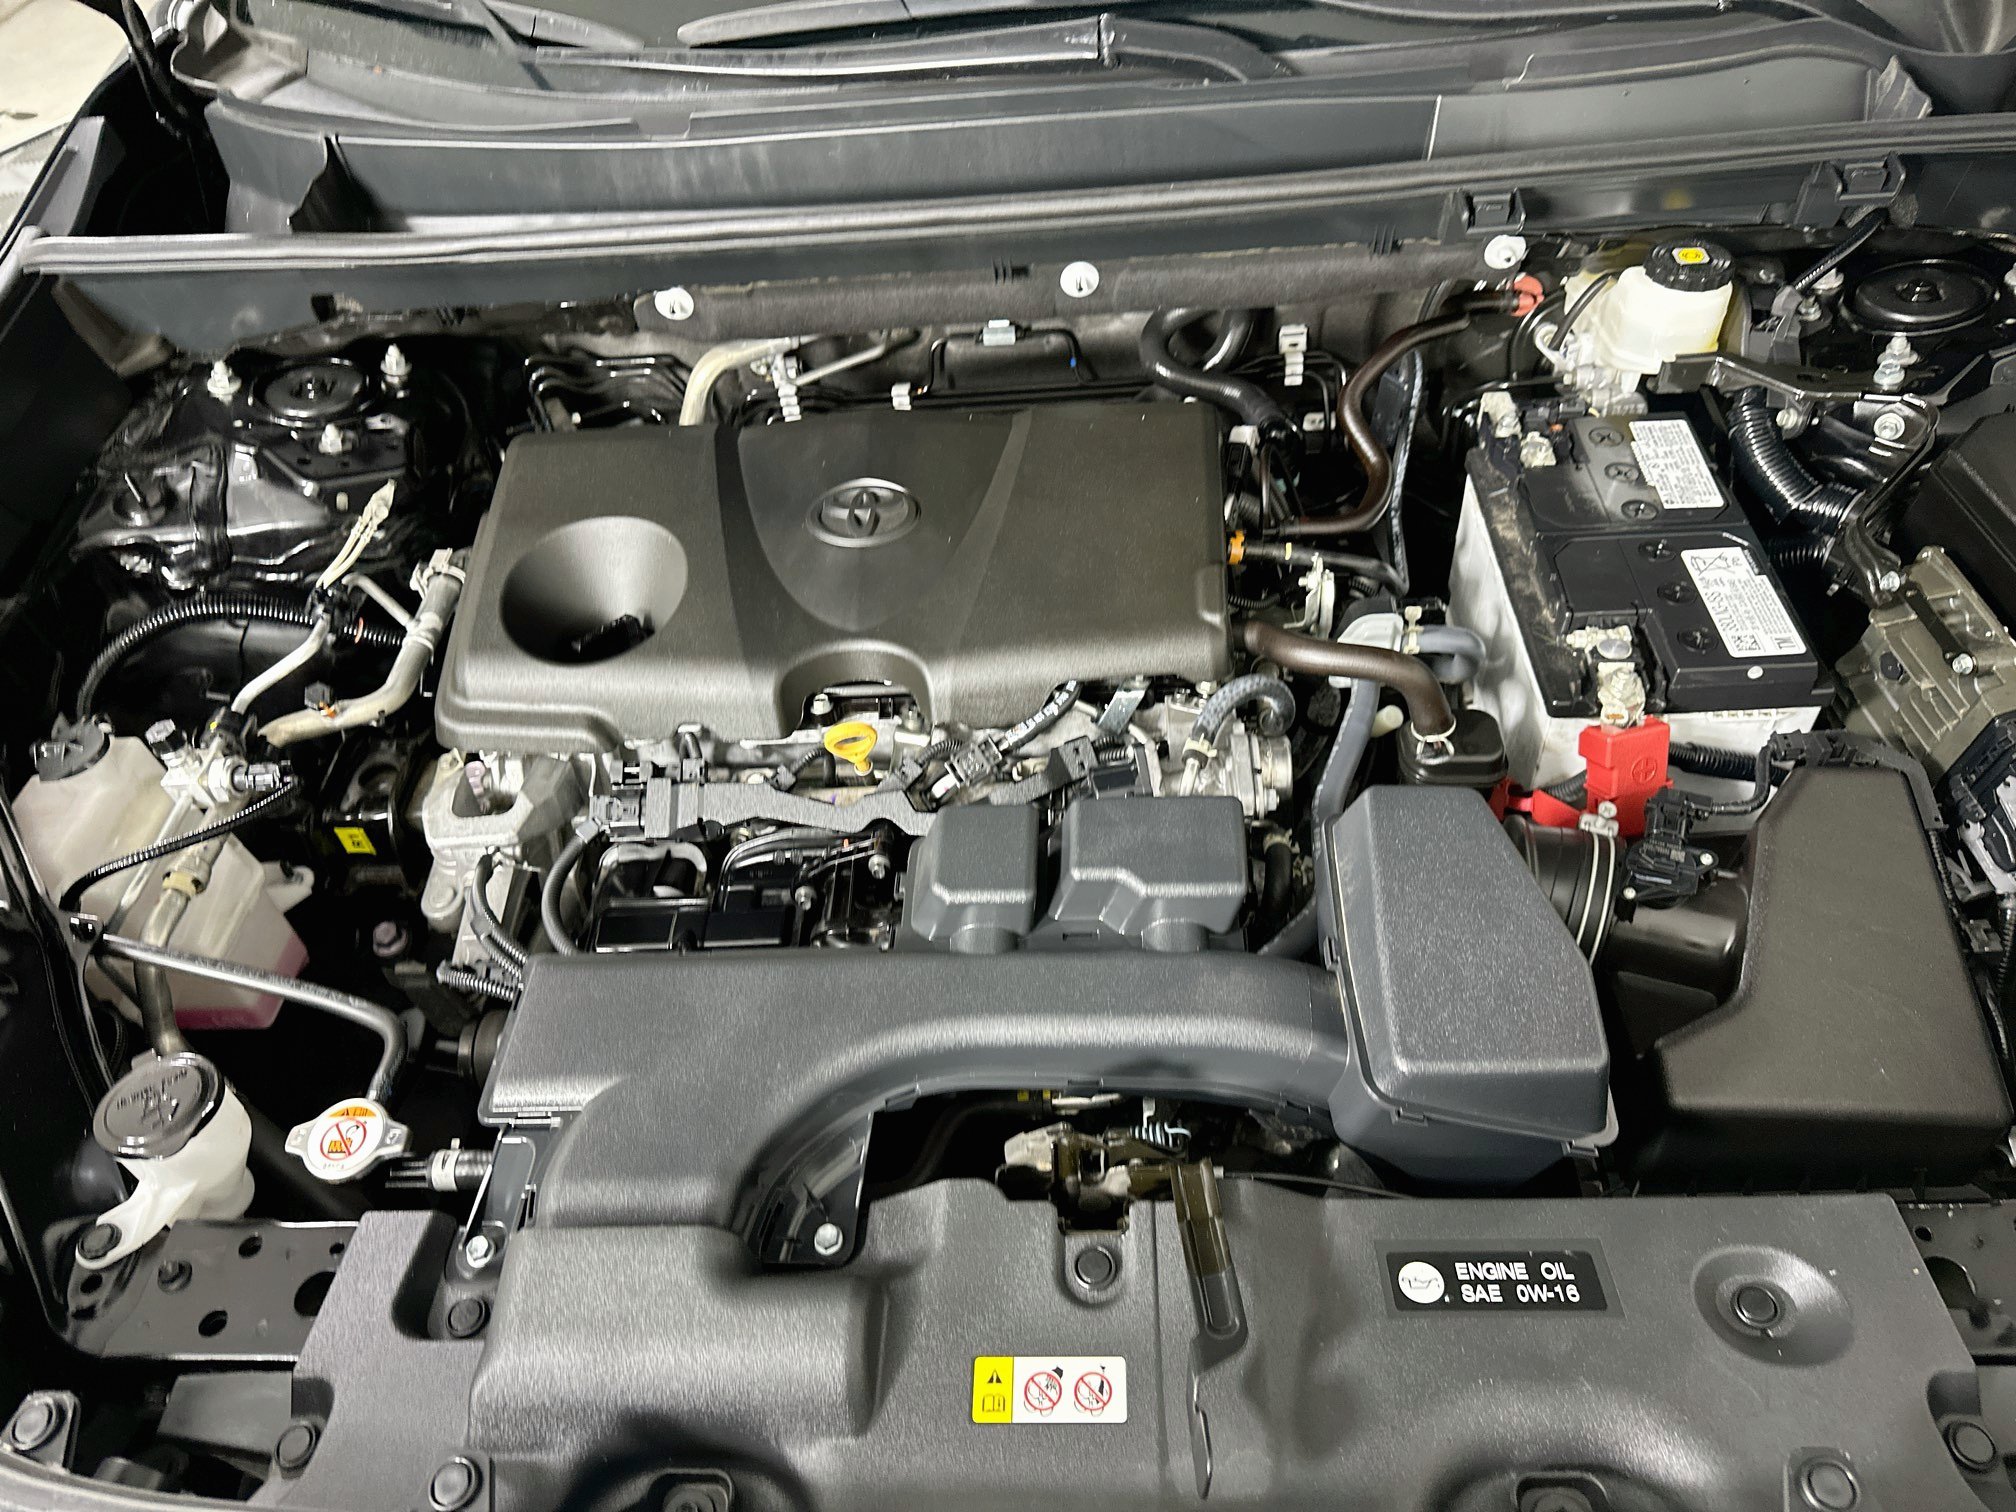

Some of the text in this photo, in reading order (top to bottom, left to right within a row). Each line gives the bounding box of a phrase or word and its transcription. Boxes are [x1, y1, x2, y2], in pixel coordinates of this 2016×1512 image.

[1454, 1261, 1576, 1281] ENGINE OIL
[1460, 1284, 1581, 1304] SAE 0W-16
